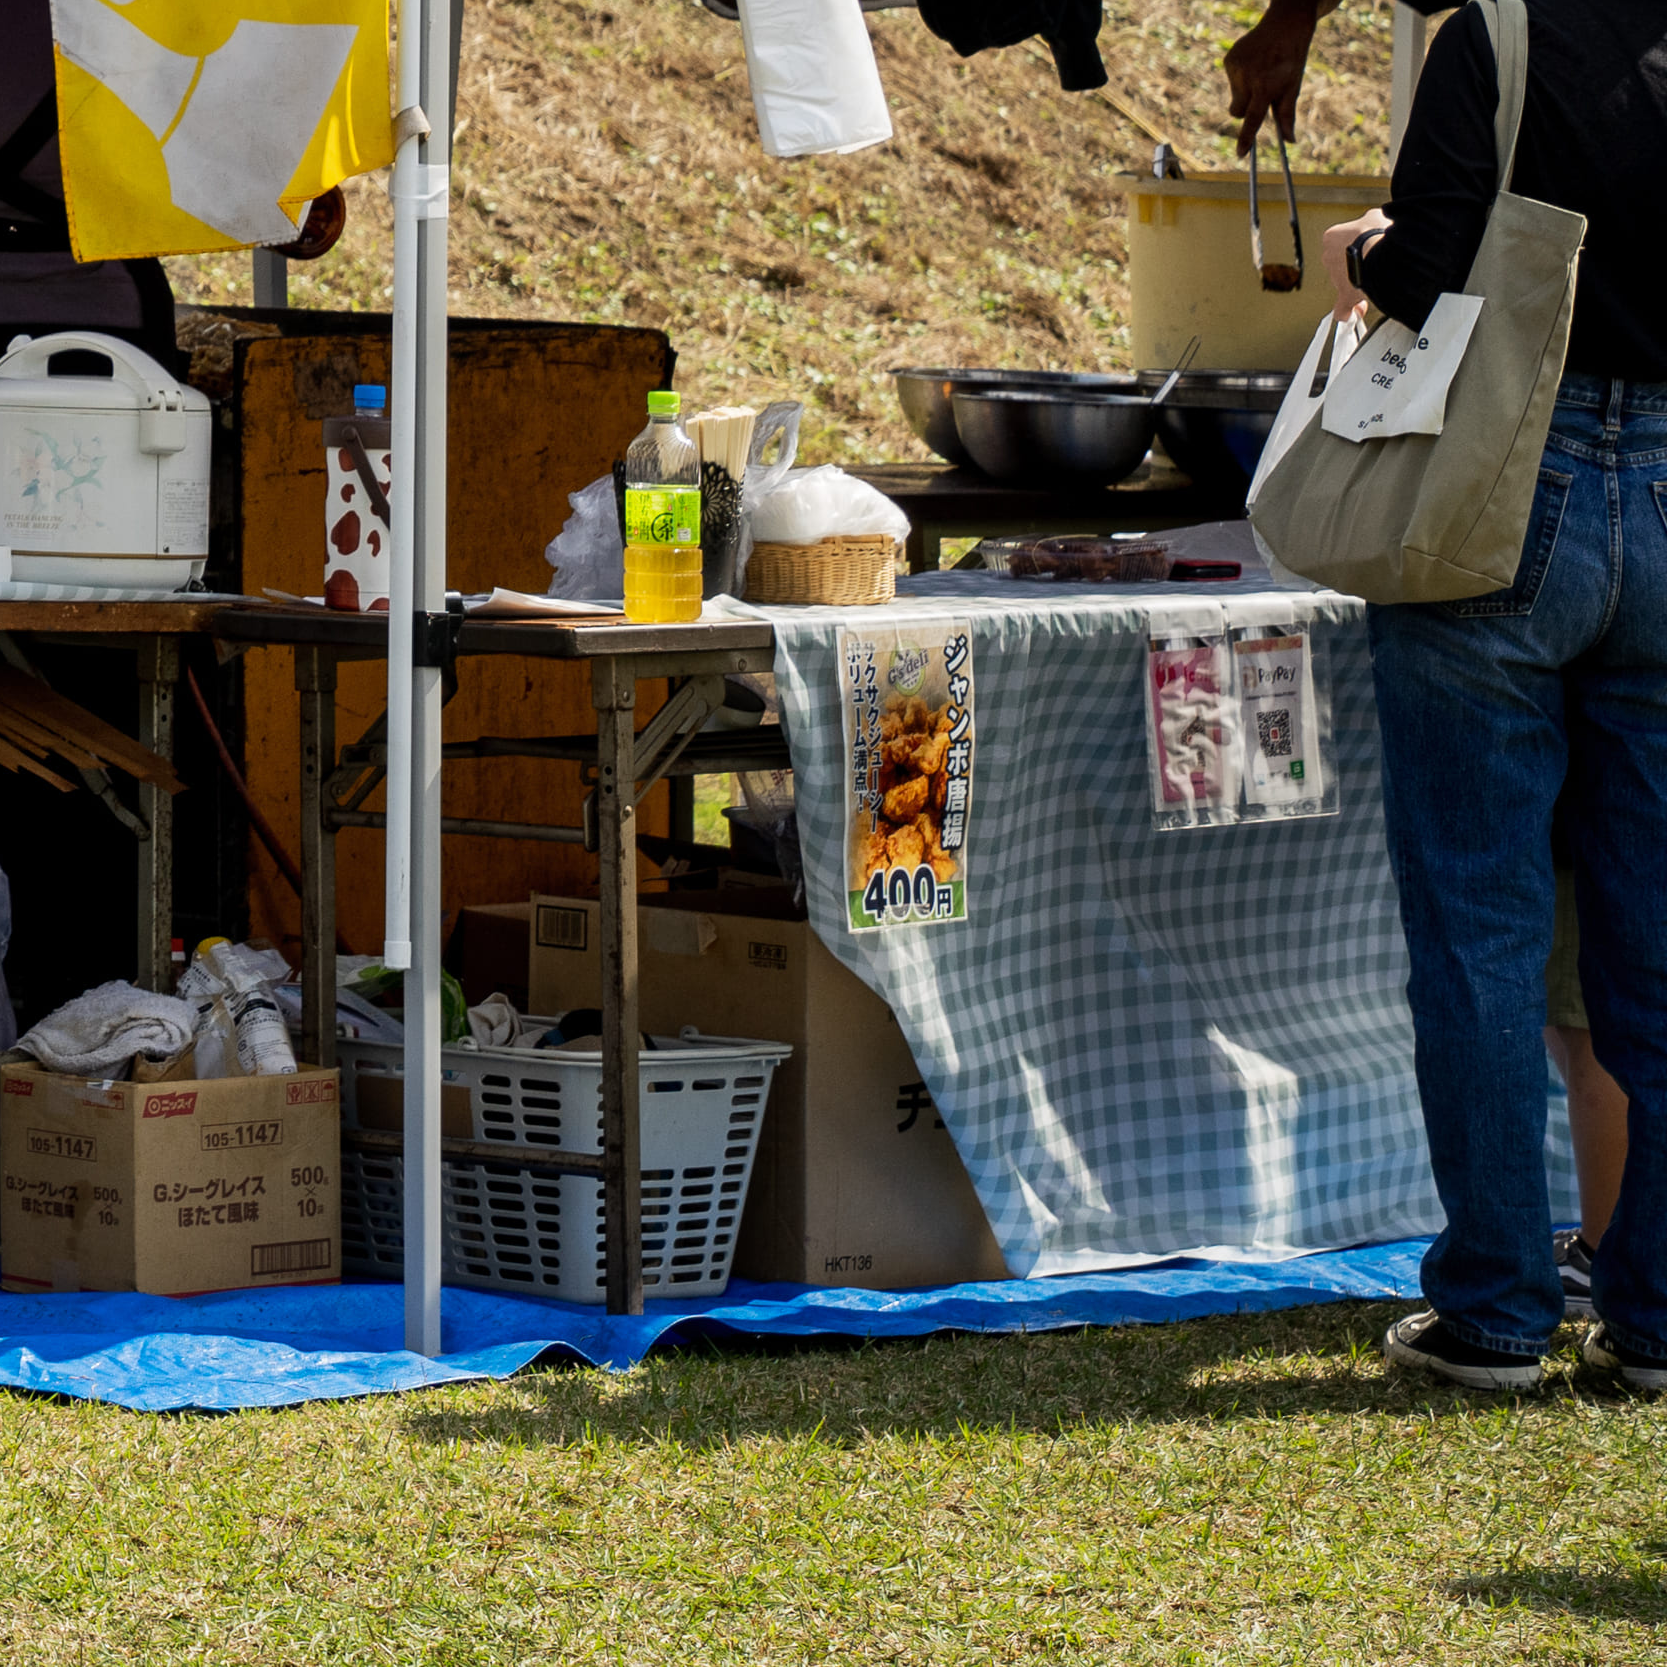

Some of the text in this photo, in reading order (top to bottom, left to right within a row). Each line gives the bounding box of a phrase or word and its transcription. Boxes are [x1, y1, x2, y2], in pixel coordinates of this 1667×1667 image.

[1258, 666, 1296, 684] PayPay
[942, 633, 971, 850] ジャンボ唐揚
[863, 864, 953, 921] 400円
[162, 1096, 194, 1112] ニッスイ
[30, 1136, 94, 1159] 105-1147
[205, 1123, 280, 1148] 105-1147
[154, 1176, 266, 1203] G.シーグレイス
[178, 1200, 260, 1228] ほたて風味
[825, 1255, 872, 1273] HKT136
